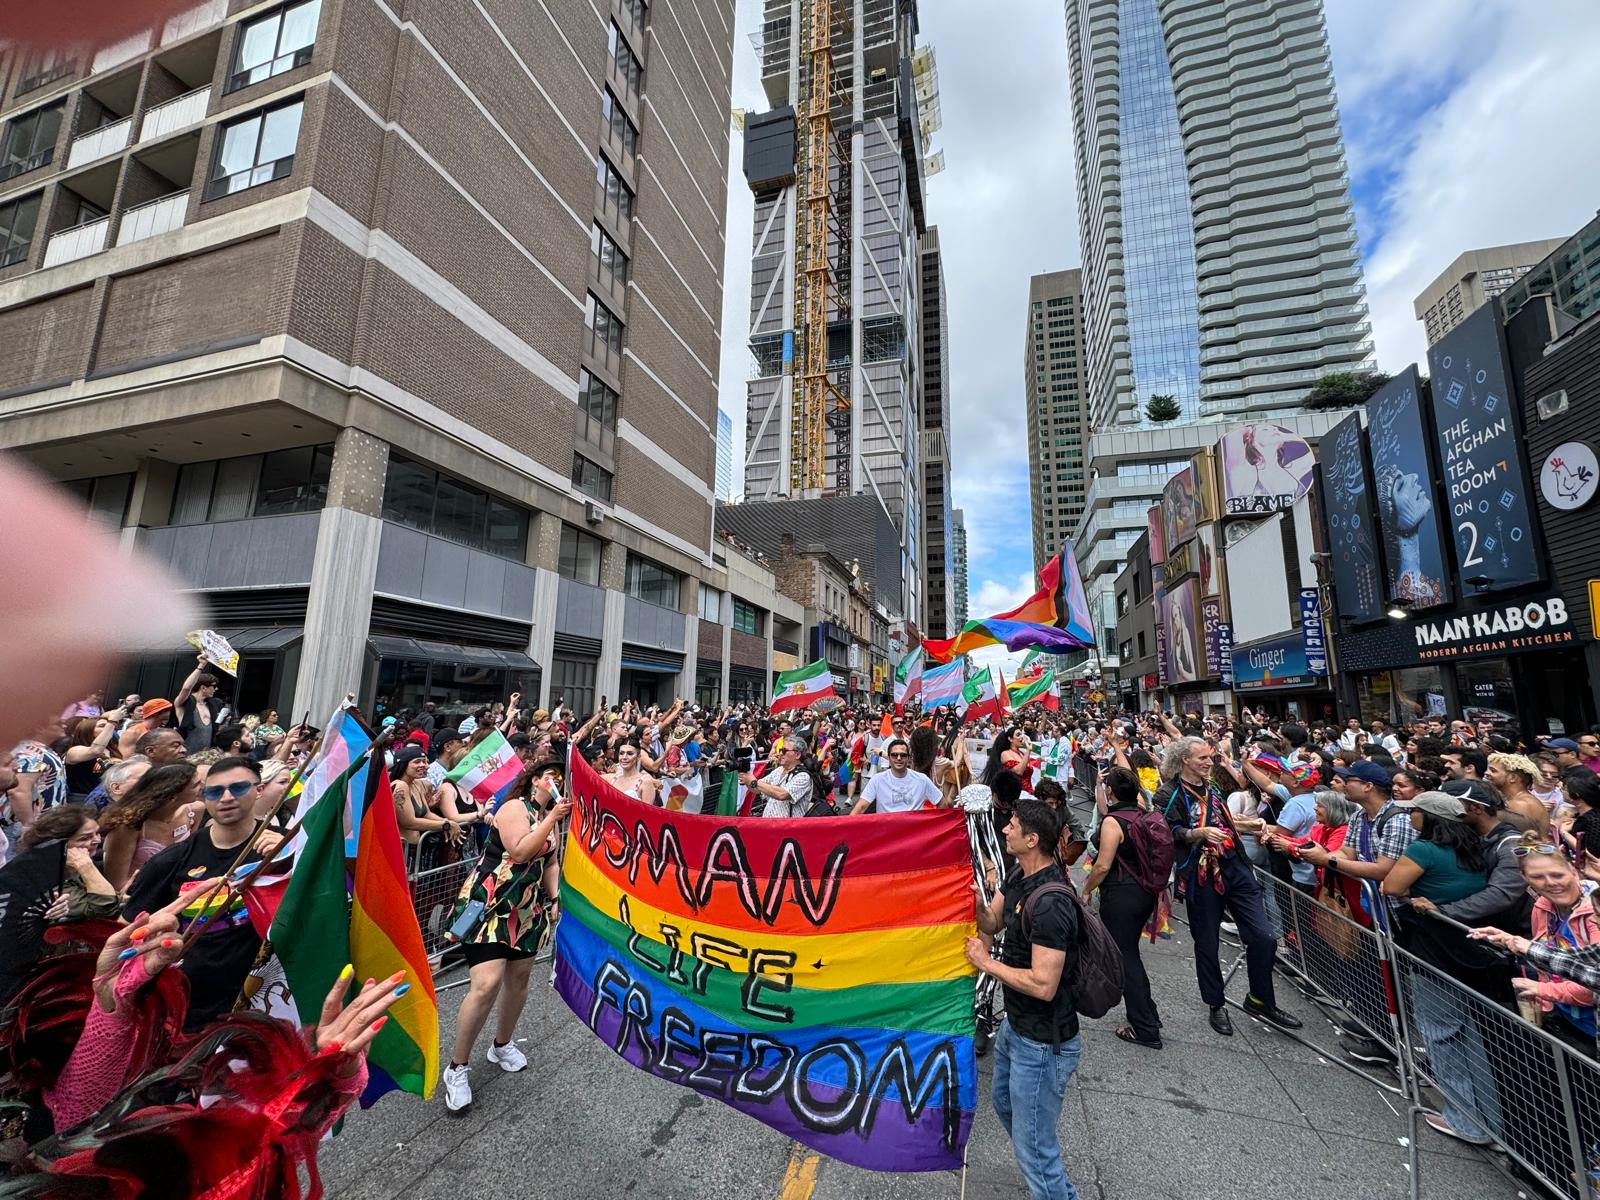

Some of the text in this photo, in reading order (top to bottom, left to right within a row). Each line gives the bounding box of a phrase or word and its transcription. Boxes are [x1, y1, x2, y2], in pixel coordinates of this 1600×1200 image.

[1442, 418, 1470, 444] THE
[1446, 418, 1506, 463] AFGHAN
[1448, 458, 1475, 480] TEA
[1451, 466, 1497, 499] ROOM
[1226, 494, 1296, 514] BLAME
[1454, 499, 1473, 517] ON
[1458, 521, 1484, 568] 2
[1203, 604, 1219, 617] ER
[1301, 591, 1322, 646] GINGER
[1473, 598, 1568, 637] KABOB
[1218, 624, 1232, 665] GINGER
[1249, 648, 1285, 671] Ginger
[1419, 632, 1573, 659] MODERN AFGHAN KITCHEN
[579, 795, 849, 927] WOMAN
[619, 894, 797, 1024] LIFE
[589, 958, 961, 1150] FREEDOM
